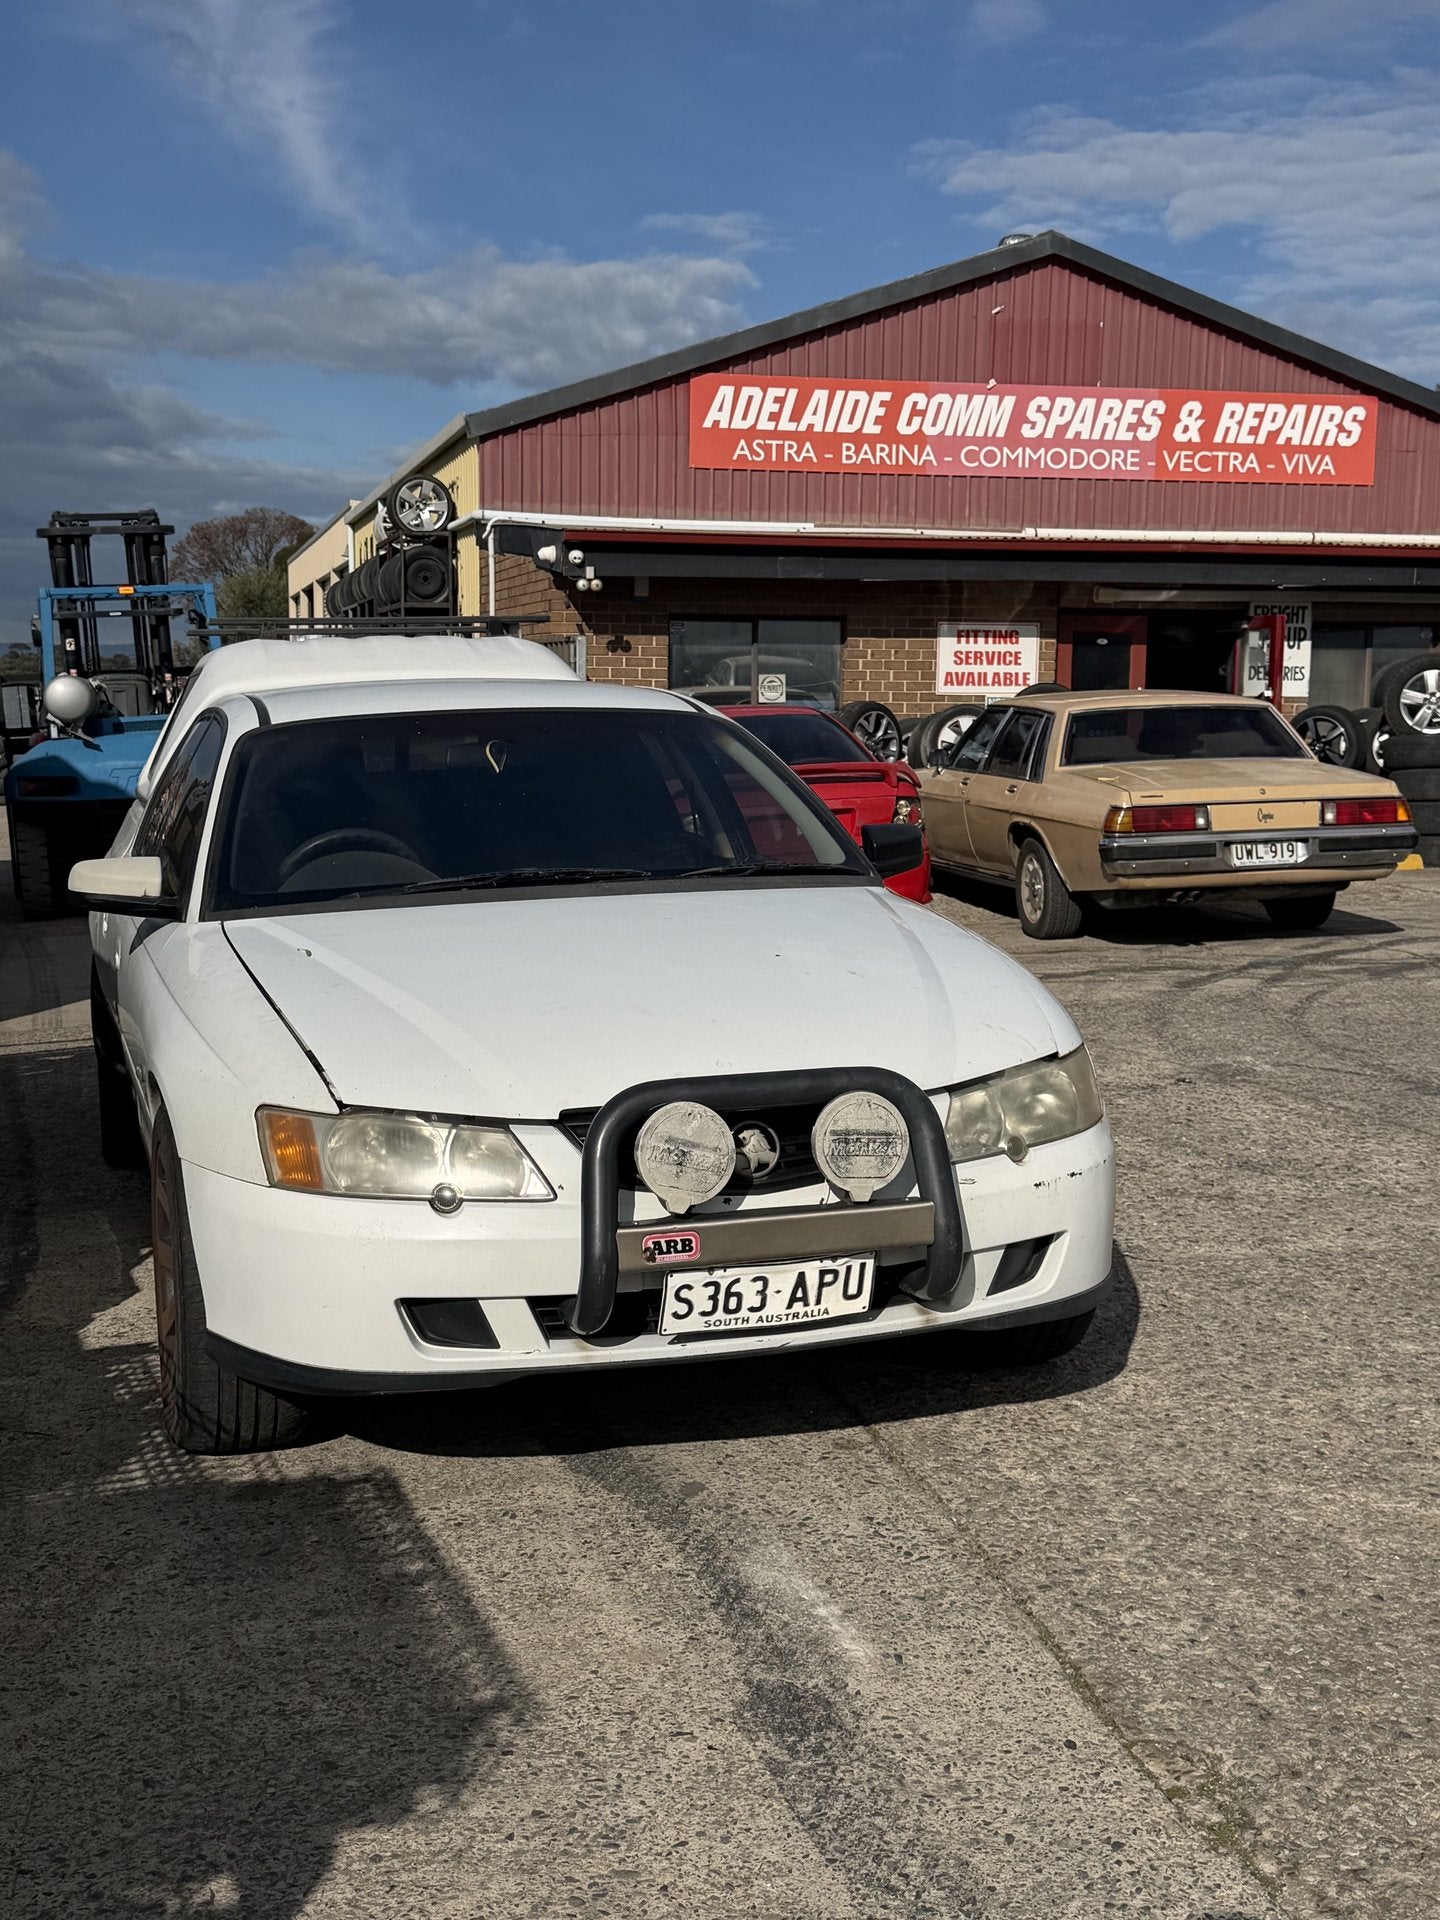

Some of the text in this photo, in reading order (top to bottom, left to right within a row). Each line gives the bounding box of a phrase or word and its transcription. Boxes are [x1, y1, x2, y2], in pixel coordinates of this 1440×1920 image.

[703, 385, 1367, 447] ADELAIDE COMM SPARES & REPAIRS
[732, 439, 818, 463] ASTRA
[841, 442, 938, 466] BARINA
[960, 445, 1141, 471] COMMODORE
[1162, 451, 1261, 474] VECTRA
[1281, 453, 1336, 476] VIVA
[956, 629, 1020, 645] FITTING
[953, 650, 1022, 666] SERVICE
[943, 671, 1031, 687] AVAILABLE
[1248, 664, 1305, 681] DELRIES
[1235, 842, 1295, 860] UWL 919
[652, 1238, 694, 1256] ARB
[703, 1307, 830, 1328] SOUTH AUSTRALIA
